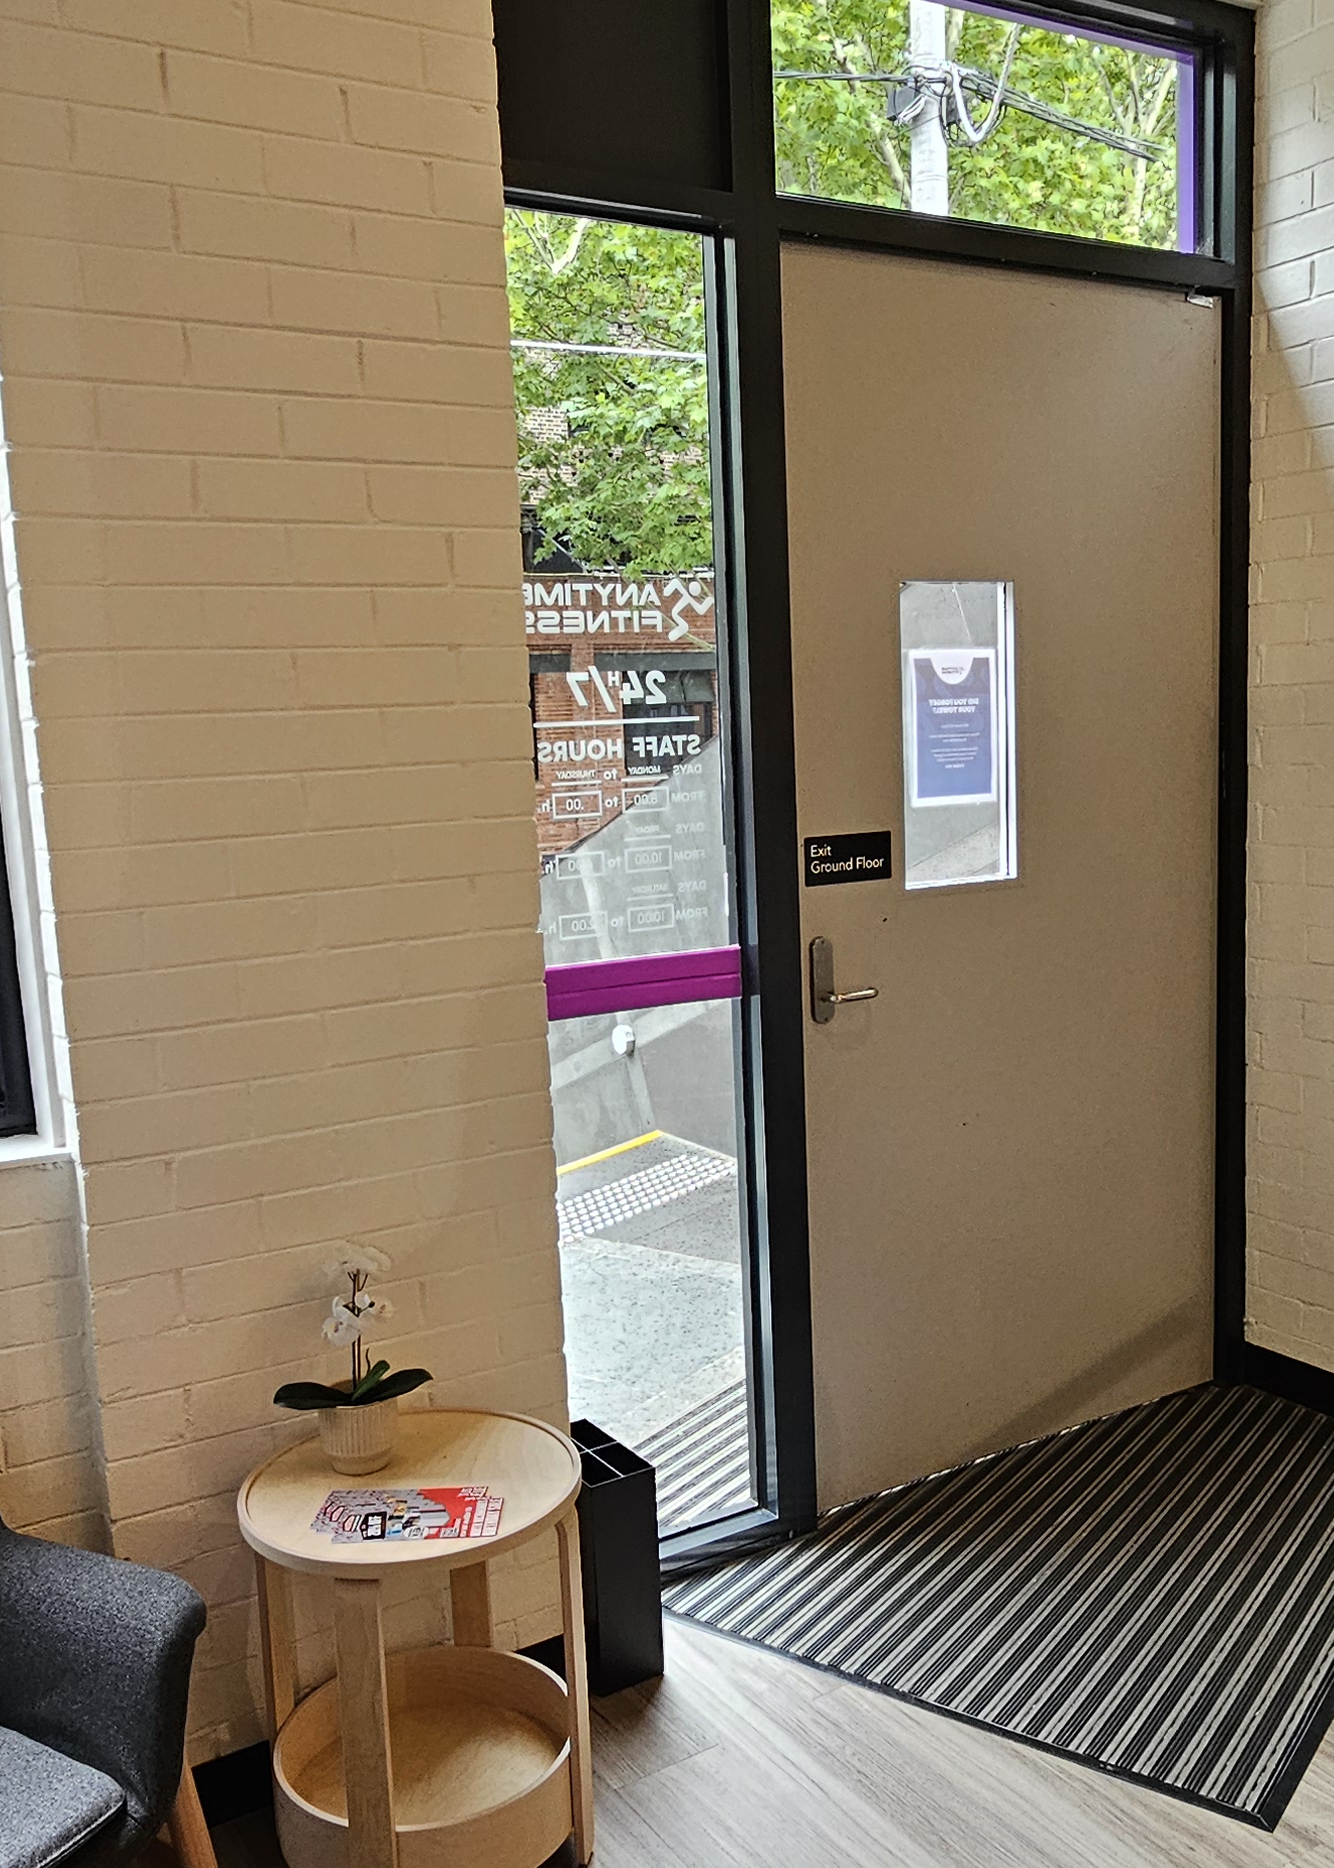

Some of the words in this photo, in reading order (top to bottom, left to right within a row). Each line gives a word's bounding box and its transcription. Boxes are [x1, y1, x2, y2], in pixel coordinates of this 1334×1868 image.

[810, 844, 832, 857] Exit
[810, 857, 853, 874] Ground
[856, 856, 884, 870] Floor
